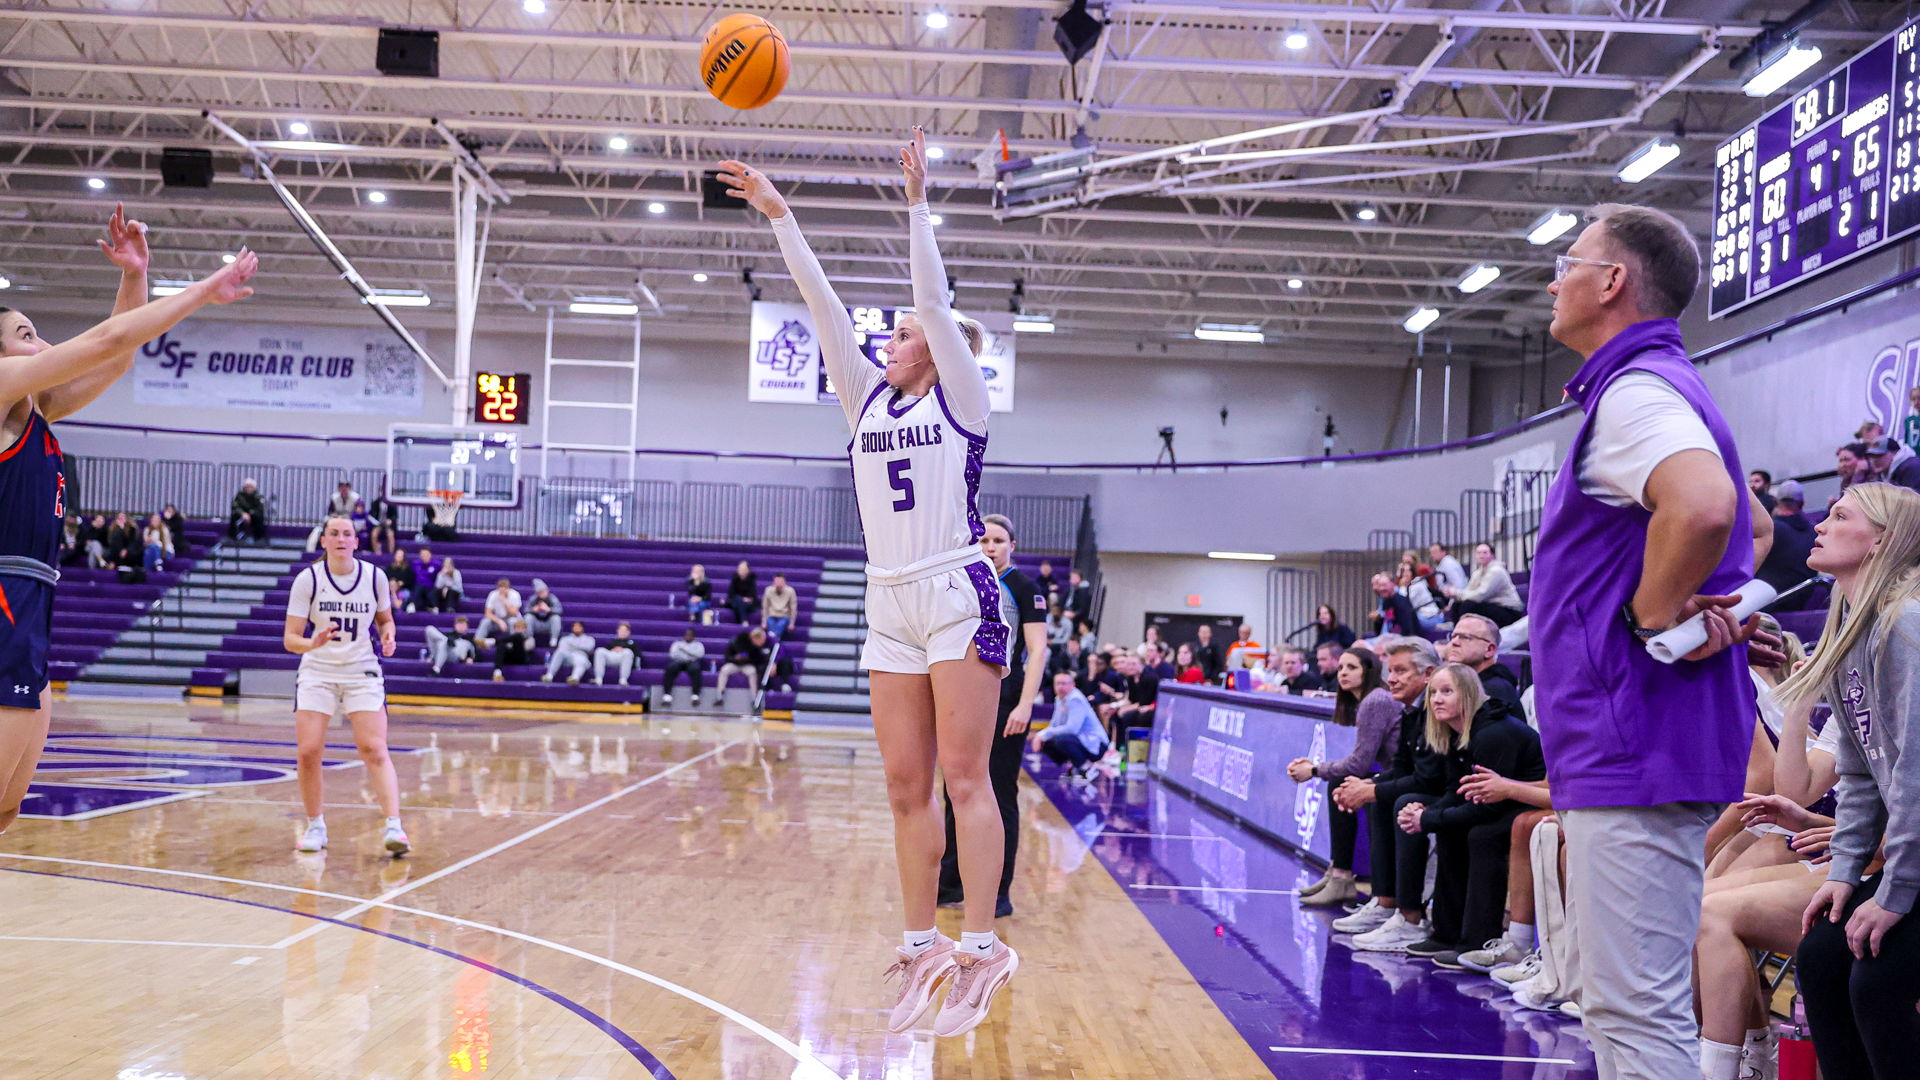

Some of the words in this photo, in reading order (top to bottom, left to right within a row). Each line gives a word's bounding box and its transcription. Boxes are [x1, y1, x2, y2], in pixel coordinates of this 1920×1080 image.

[706, 38, 749, 90] Wilson
[1794, 79, 1835, 139] 58.1
[1853, 124, 1880, 177] 65
[1810, 163, 1822, 192] 4
[1763, 177, 1787, 225] 60
[1838, 201, 1852, 237] 2
[141, 332, 198, 378] USF
[208, 351, 294, 375] COUGAR
[300, 353, 355, 378] CLUB
[757, 341, 811, 377] USF
[478, 374, 516, 393] 58.1
[760, 379, 806, 389] COUGARS
[483, 391, 518, 421] 22
[861, 431, 895, 453] SIOUX
[898, 423, 942, 449] FALLS
[886, 458, 915, 512] 5
[319, 601, 342, 612] SIOUX
[345, 602, 370, 613] FALLS
[329, 616, 358, 642] 24
